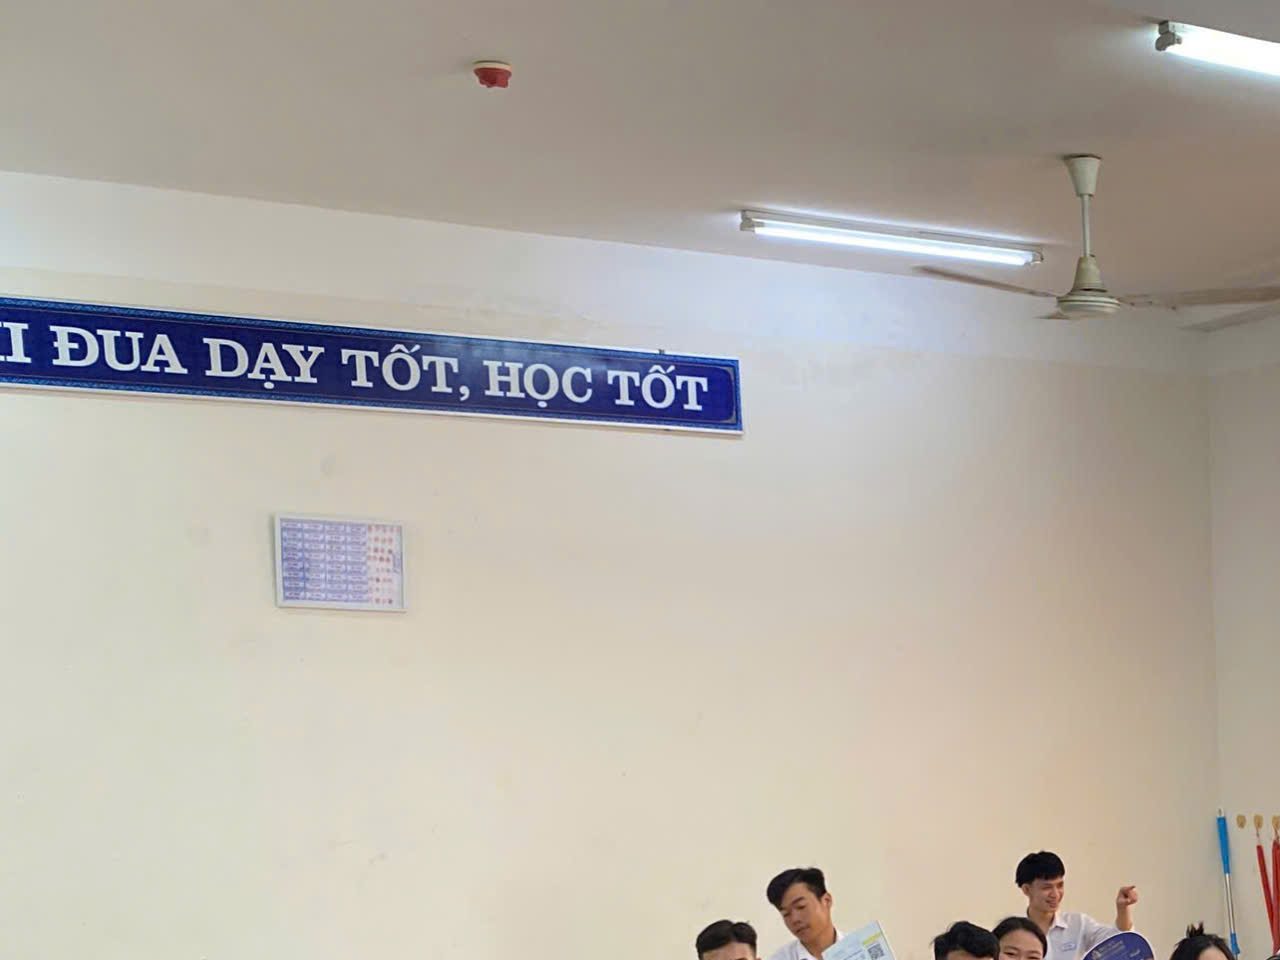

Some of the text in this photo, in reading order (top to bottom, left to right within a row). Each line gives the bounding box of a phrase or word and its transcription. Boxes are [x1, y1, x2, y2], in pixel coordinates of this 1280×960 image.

[0, 321, 708, 411] I ĐUA DẠY TỐT, HỌC TỐT
